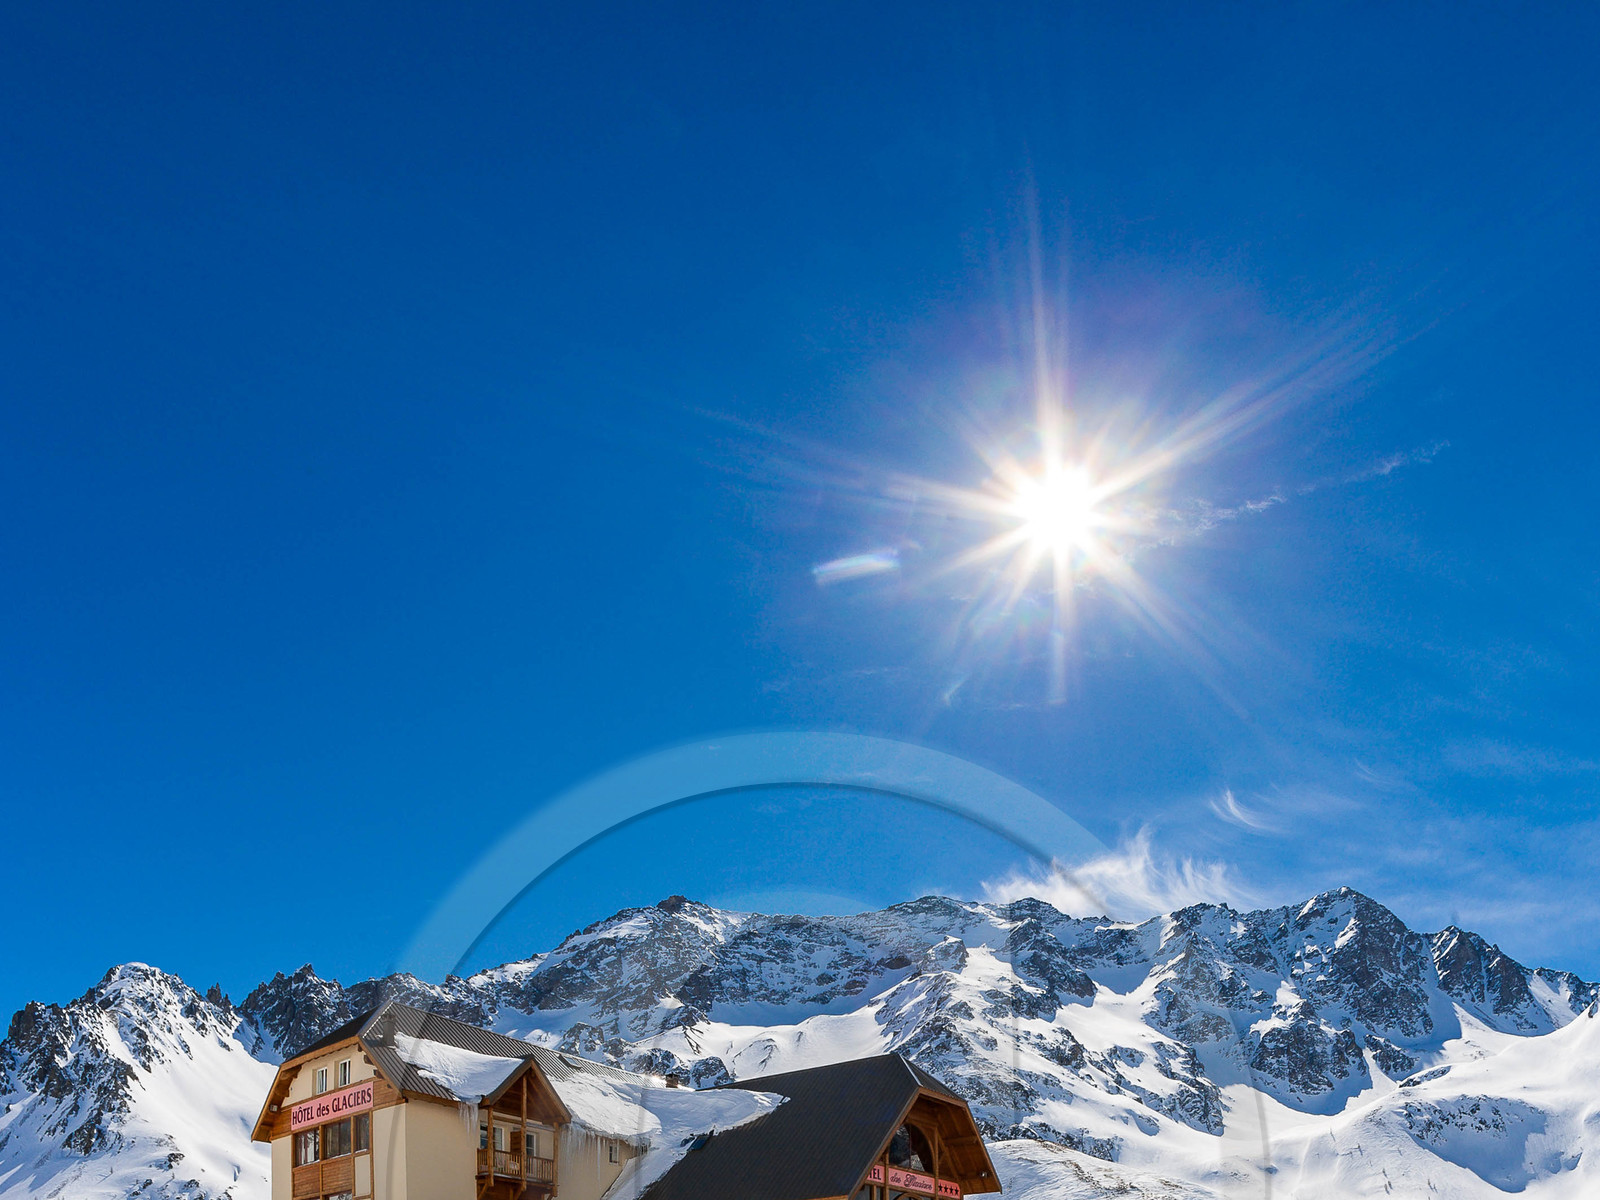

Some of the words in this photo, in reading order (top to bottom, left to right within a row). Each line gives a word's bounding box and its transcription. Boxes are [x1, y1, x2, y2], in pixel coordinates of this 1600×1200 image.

[292, 1106, 314, 1125] HÔTEL
[316, 1103, 330, 1117] des
[331, 1087, 372, 1113] GLACIERS
